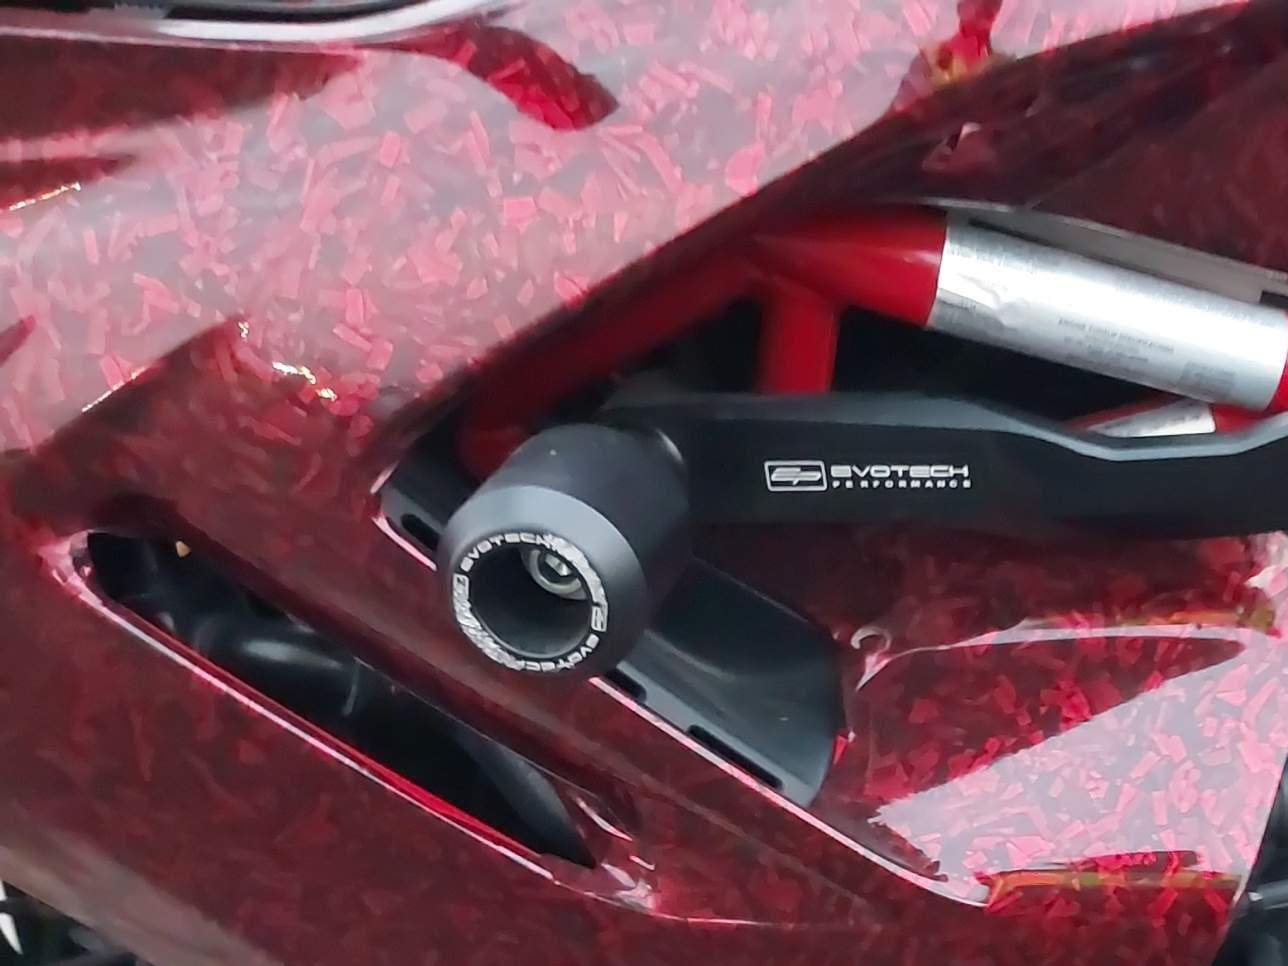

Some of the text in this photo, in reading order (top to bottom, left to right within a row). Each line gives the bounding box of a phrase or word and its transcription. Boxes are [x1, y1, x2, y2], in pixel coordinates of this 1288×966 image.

[830, 464, 969, 478] EVOTECH
[832, 479, 972, 489] PERFORMANCE
[460, 532, 551, 572] EVOTECH
